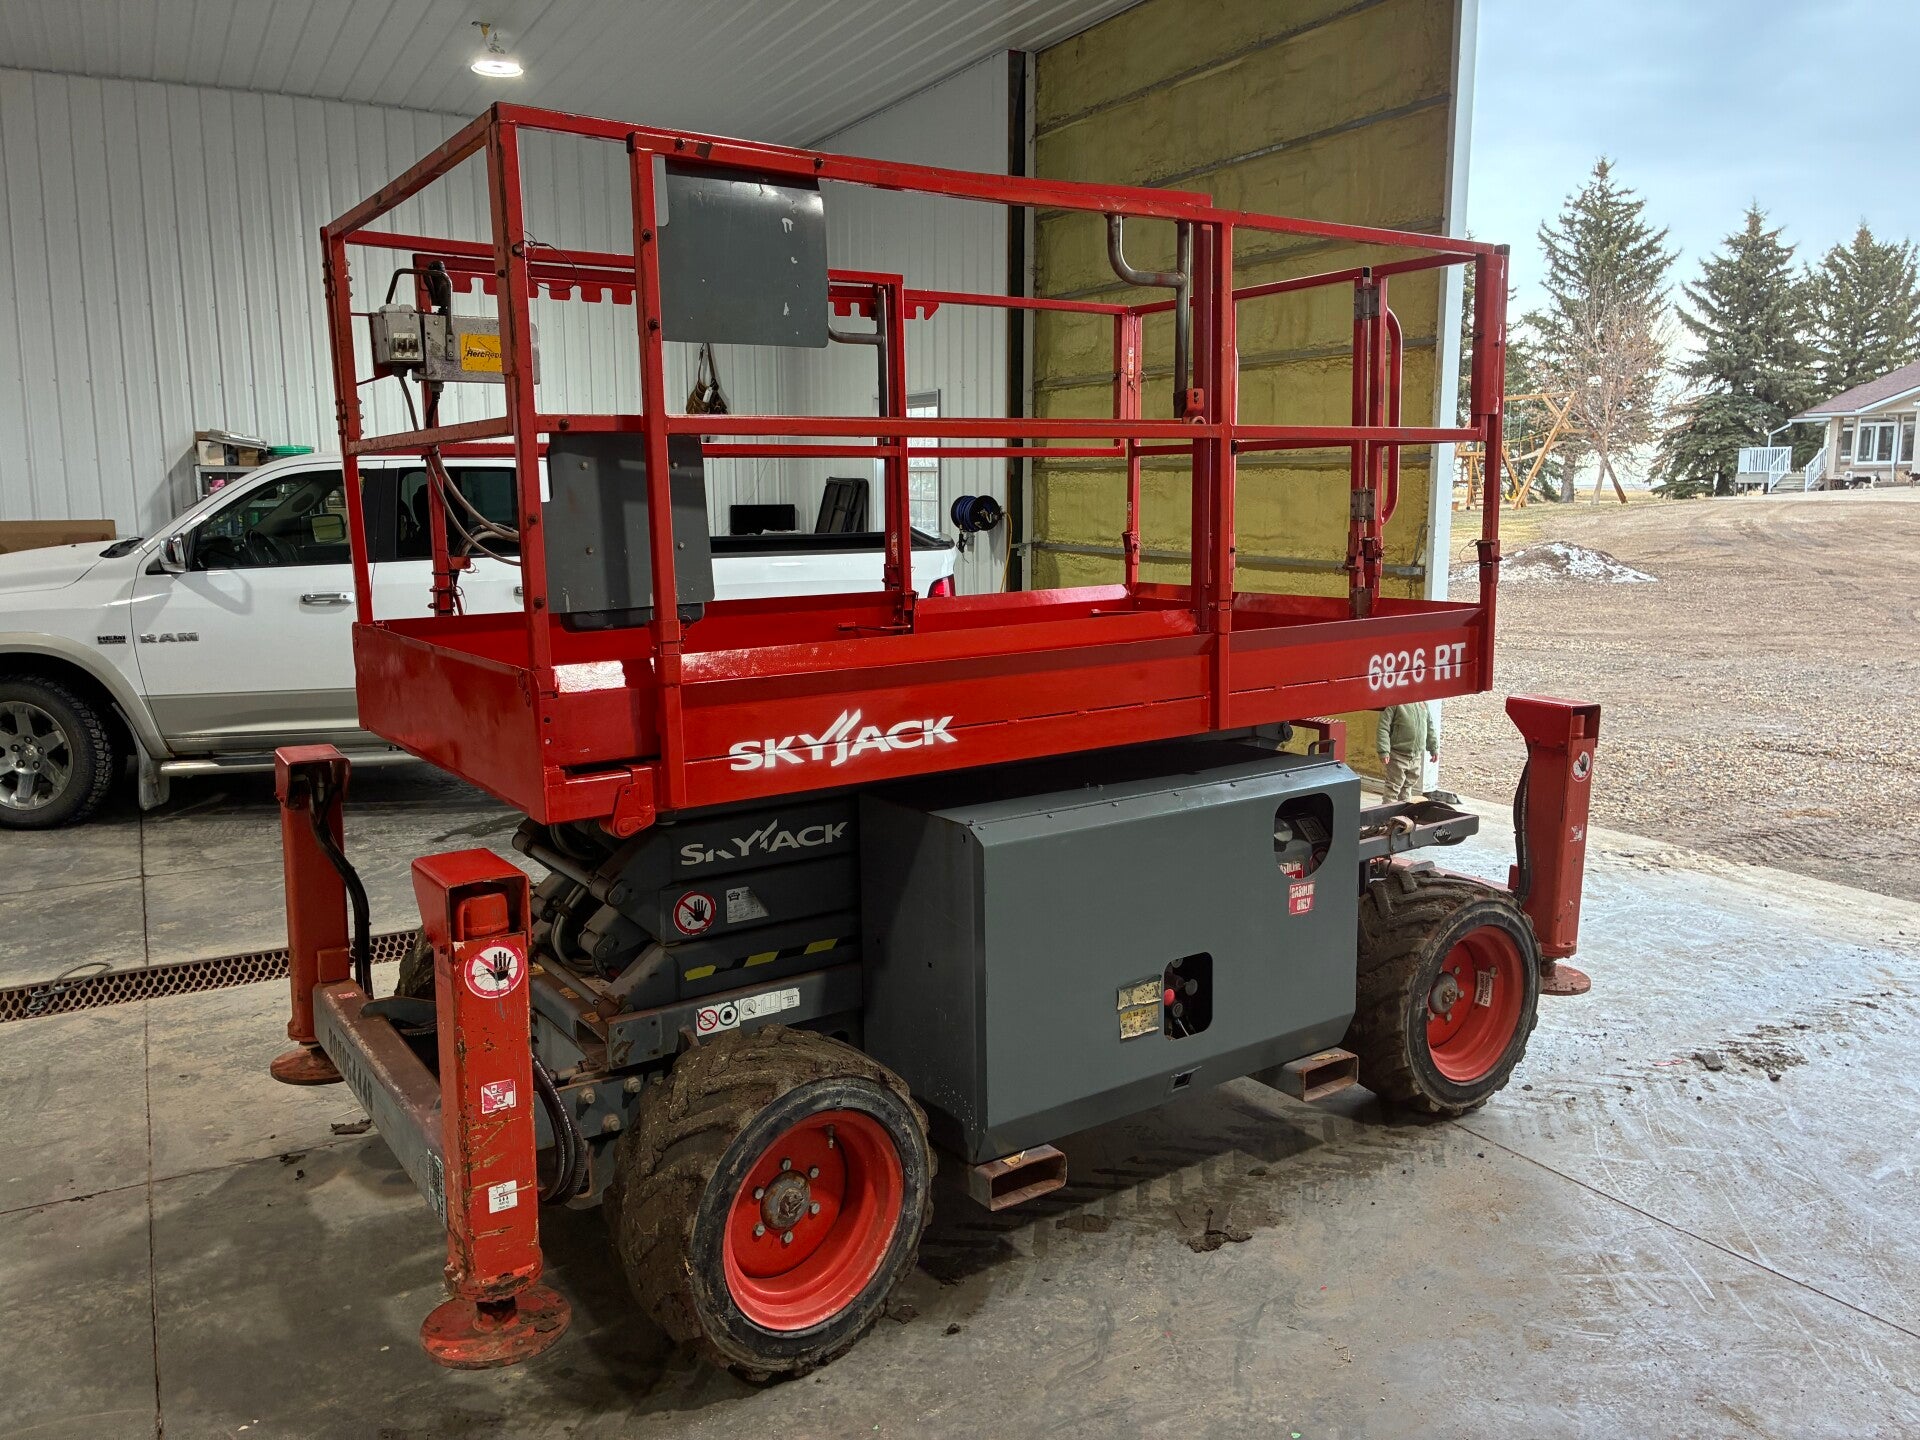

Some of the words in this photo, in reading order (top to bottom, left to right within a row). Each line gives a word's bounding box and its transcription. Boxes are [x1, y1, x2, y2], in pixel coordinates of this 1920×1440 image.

[466, 348, 502, 360] HercRen
[140, 632, 199, 644] RAM
[1368, 648, 1426, 691] 6826
[1434, 642, 1466, 681] RT
[728, 709, 958, 771] SKYJACK
[1280, 862, 1302, 875] ASOLINE
[1291, 883, 1315, 899] GASOLIN
[1296, 897, 1311, 911] ONLY
